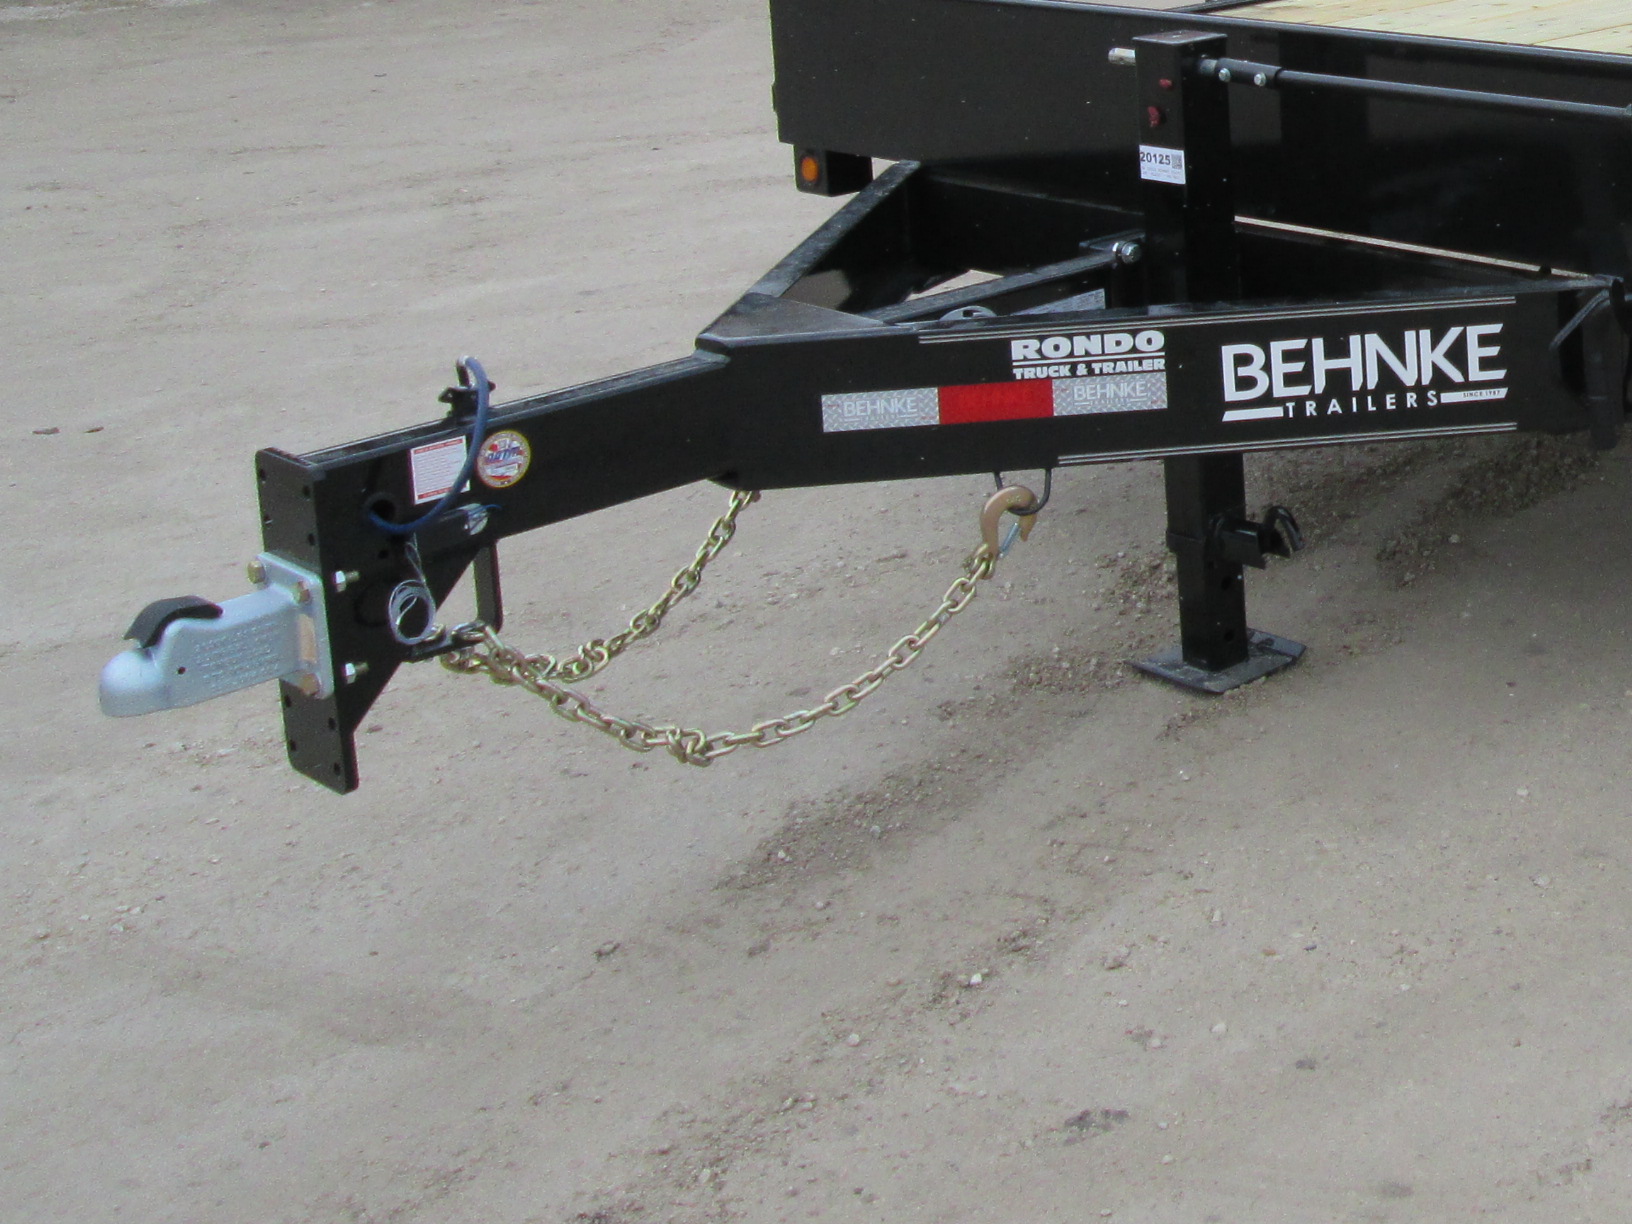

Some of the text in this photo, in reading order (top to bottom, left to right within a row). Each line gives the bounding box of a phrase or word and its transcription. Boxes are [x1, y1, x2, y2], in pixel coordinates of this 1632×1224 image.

[1139, 151, 1171, 166] 20125
[1010, 329, 1165, 361] RONDO
[1012, 357, 1166, 380] TRUCK & TRAILER
[1221, 323, 1507, 402] BEHNKE
[1073, 380, 1148, 401] BEHNKE
[843, 396, 918, 417] BEHNKE
[1286, 390, 1438, 419] TRAILERS
